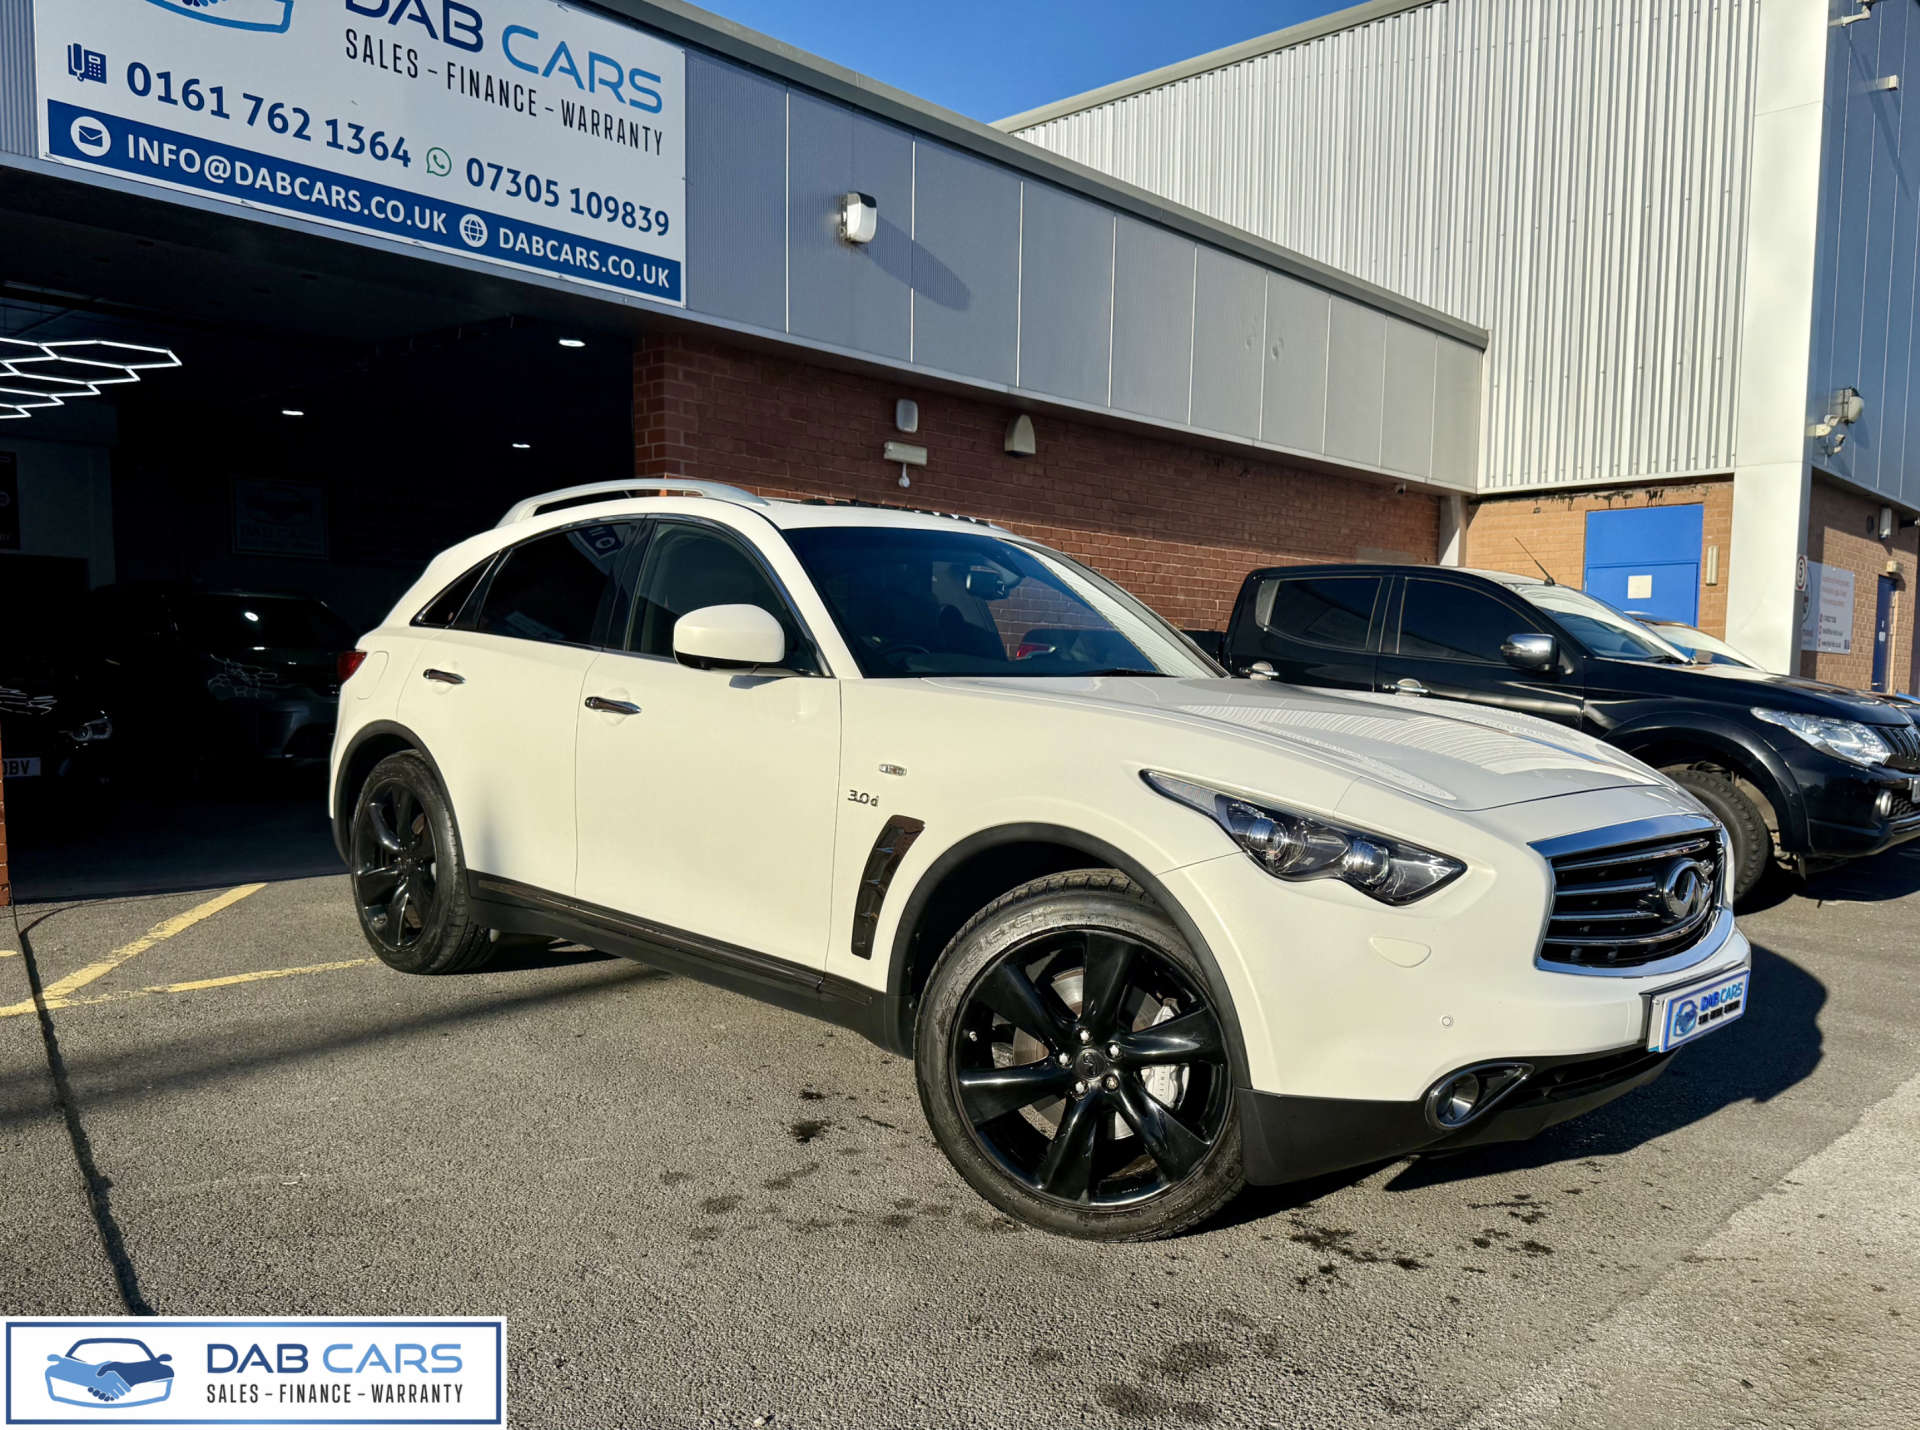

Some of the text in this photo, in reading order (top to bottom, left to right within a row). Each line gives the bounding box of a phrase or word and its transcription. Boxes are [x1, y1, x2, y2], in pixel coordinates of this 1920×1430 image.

[345, 28, 418, 79] SALES
[447, 61, 537, 117] FINANCE
[560, 98, 663, 156] WARRANTY
[501, 24, 663, 114] CARS
[126, 61, 411, 168] 0161 762 1364
[127, 133, 448, 235] INFO@DABCARS.CO.UK
[466, 157, 669, 236] 07305 109839
[499, 227, 670, 289] DABCARS.CO.UK
[1720, 982, 1743, 1003] CARS
